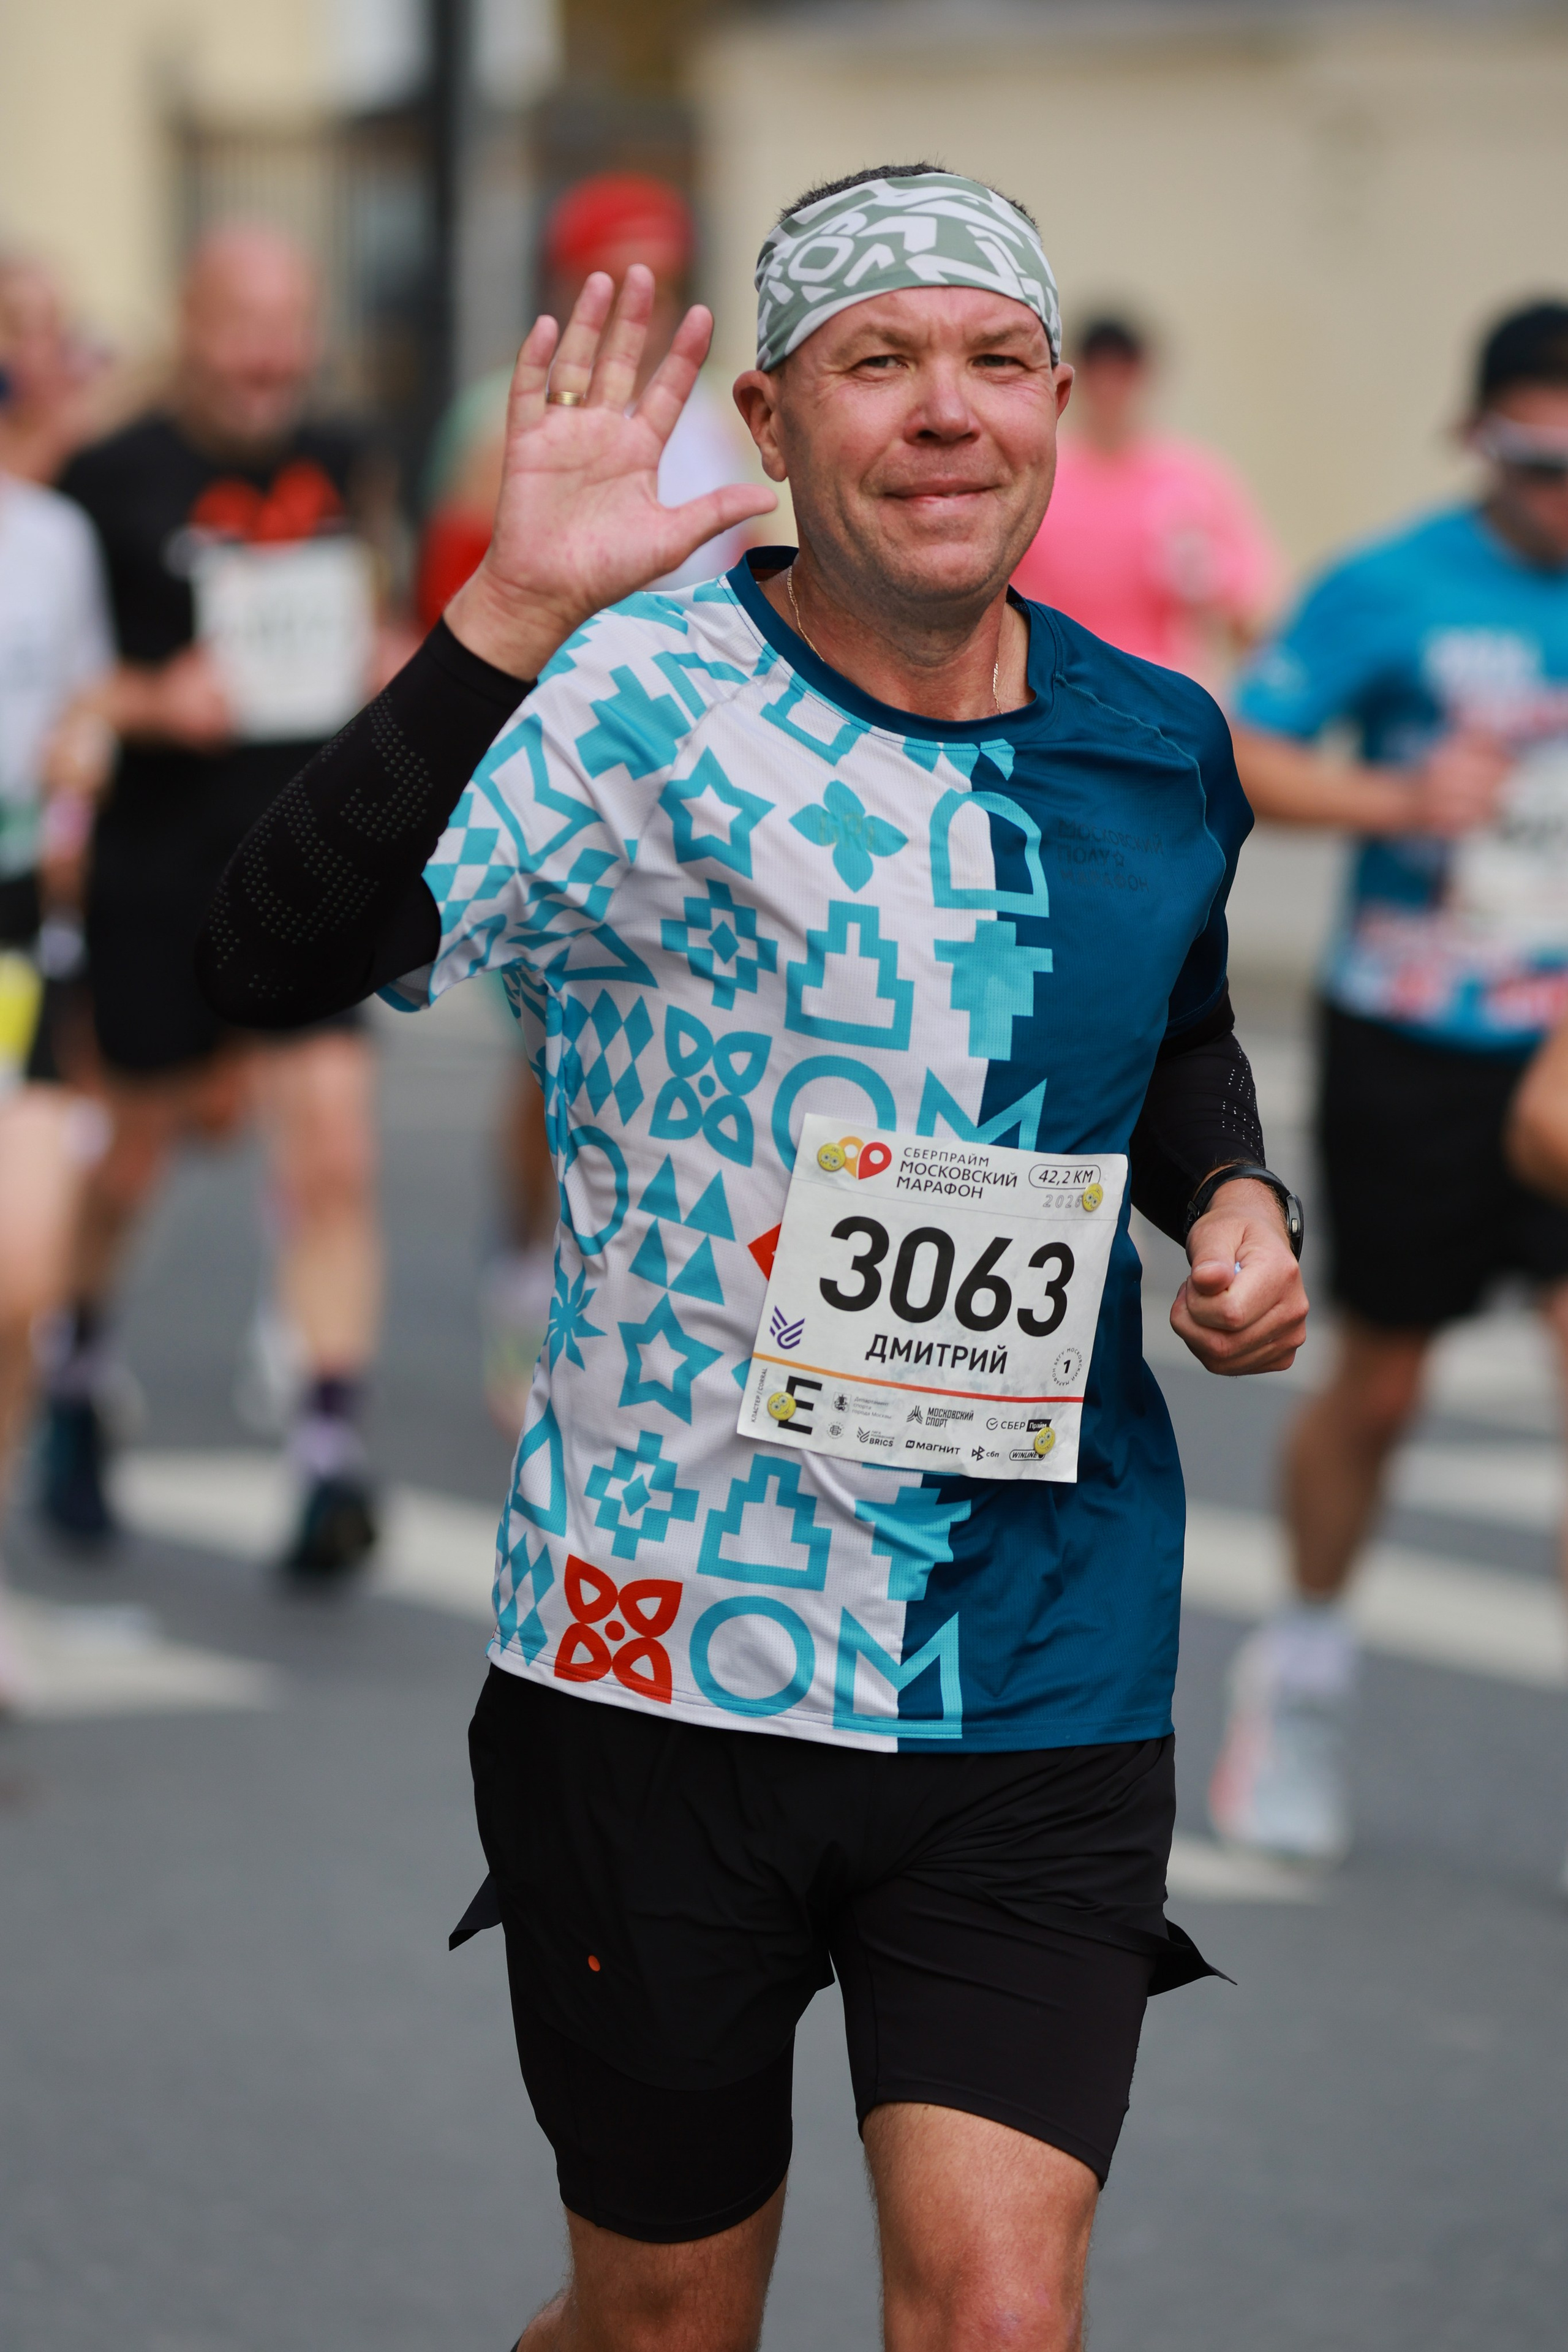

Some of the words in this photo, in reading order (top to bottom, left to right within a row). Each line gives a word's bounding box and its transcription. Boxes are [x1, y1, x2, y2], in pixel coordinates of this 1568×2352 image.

[903, 1147, 990, 1167] СБЕРПРАЙМ
[900, 1161, 1018, 1188] МОСКОВСКИЙ
[1038, 1169, 1071, 1186] 42,2
[896, 1175, 984, 1199] МАРАФОН
[819, 1215, 1076, 1338] 3063
[865, 1333, 1009, 1374] ДМИТРИЙ
[1063, 1359, 1071, 1374] 1
[750, 1395, 761, 1423] КЛАСТЕР
[758, 1368, 768, 1390] CORRAL
[777, 1375, 823, 1435] E
[925, 1417, 948, 1428] СПОРТ
[927, 1407, 974, 1422] МОСКОВСКИЙ
[1000, 1420, 1026, 1430] СБЕР
[869, 1437, 894, 1447] BRICS
[916, 1441, 961, 1455] магнит
